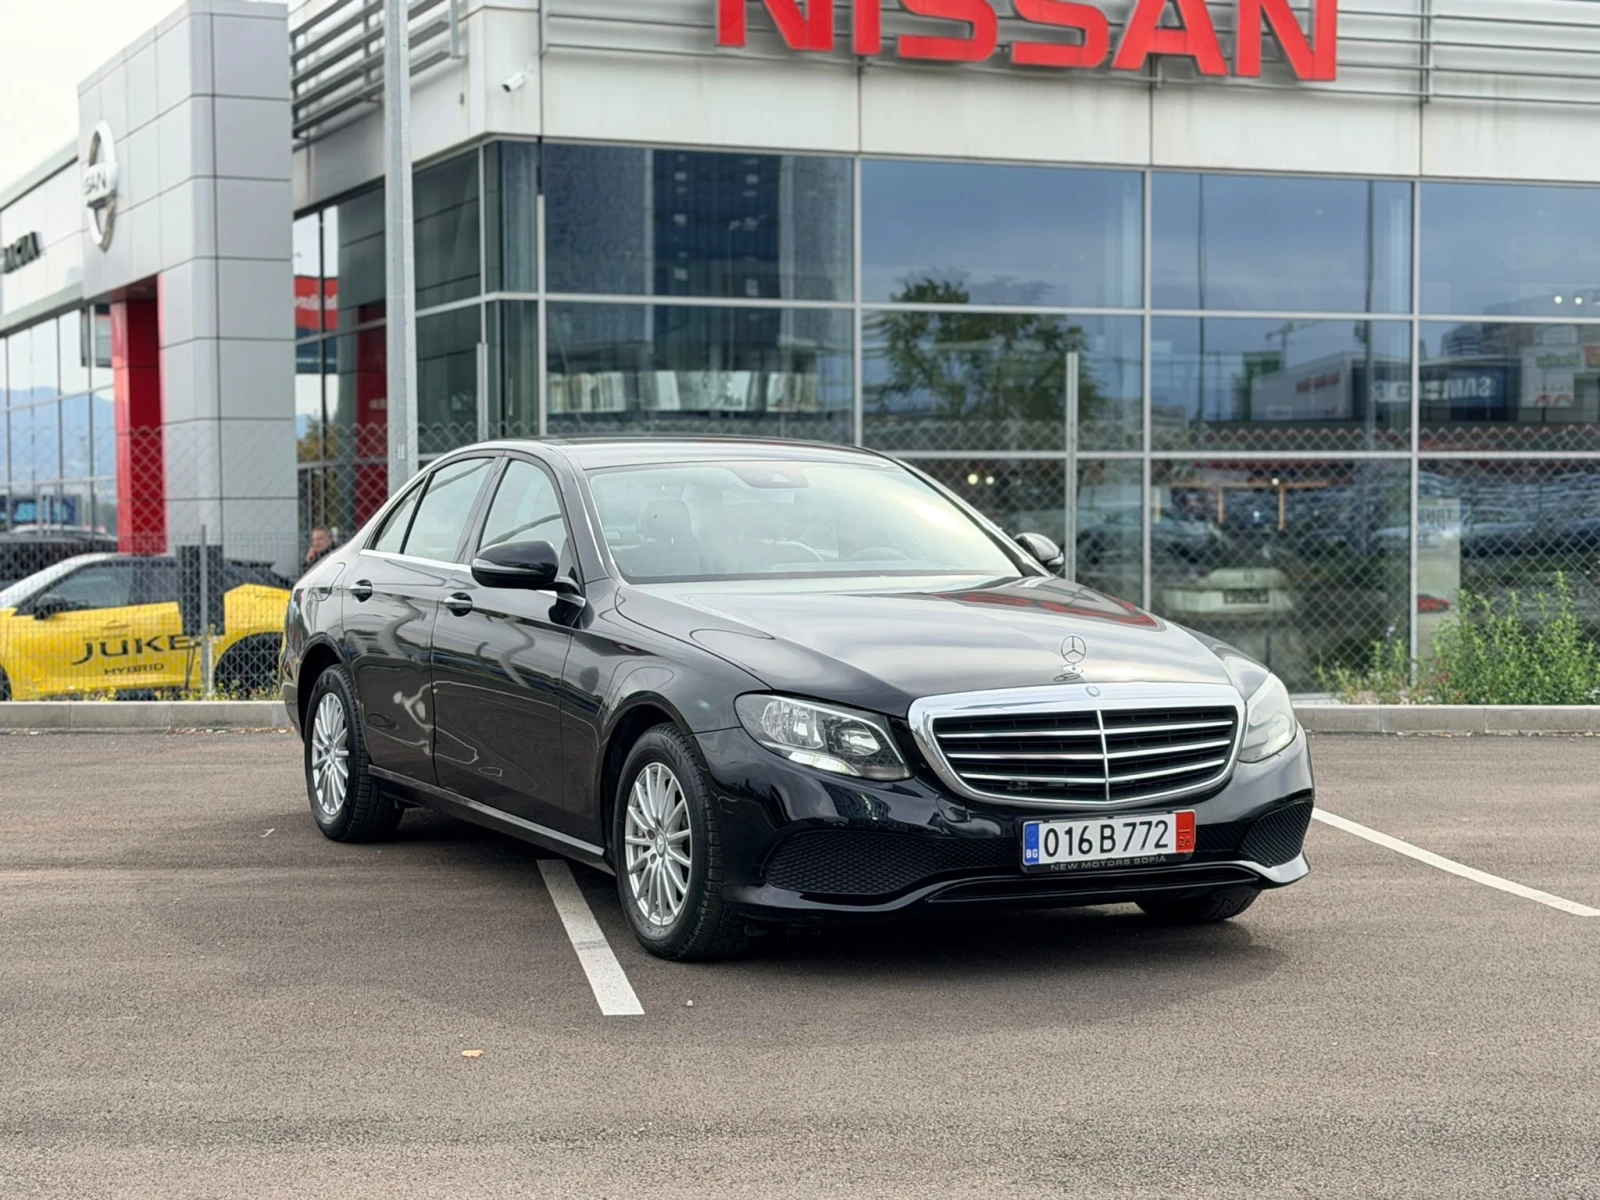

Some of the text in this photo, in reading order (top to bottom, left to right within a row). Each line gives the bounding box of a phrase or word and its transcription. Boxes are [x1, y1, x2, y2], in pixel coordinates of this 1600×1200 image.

[71, 634, 194, 666] JUKE
[104, 662, 165, 676] HYBRID
[1025, 848, 1039, 859] BG
[1050, 855, 1167, 872] NEW MOTORS SOFIA
